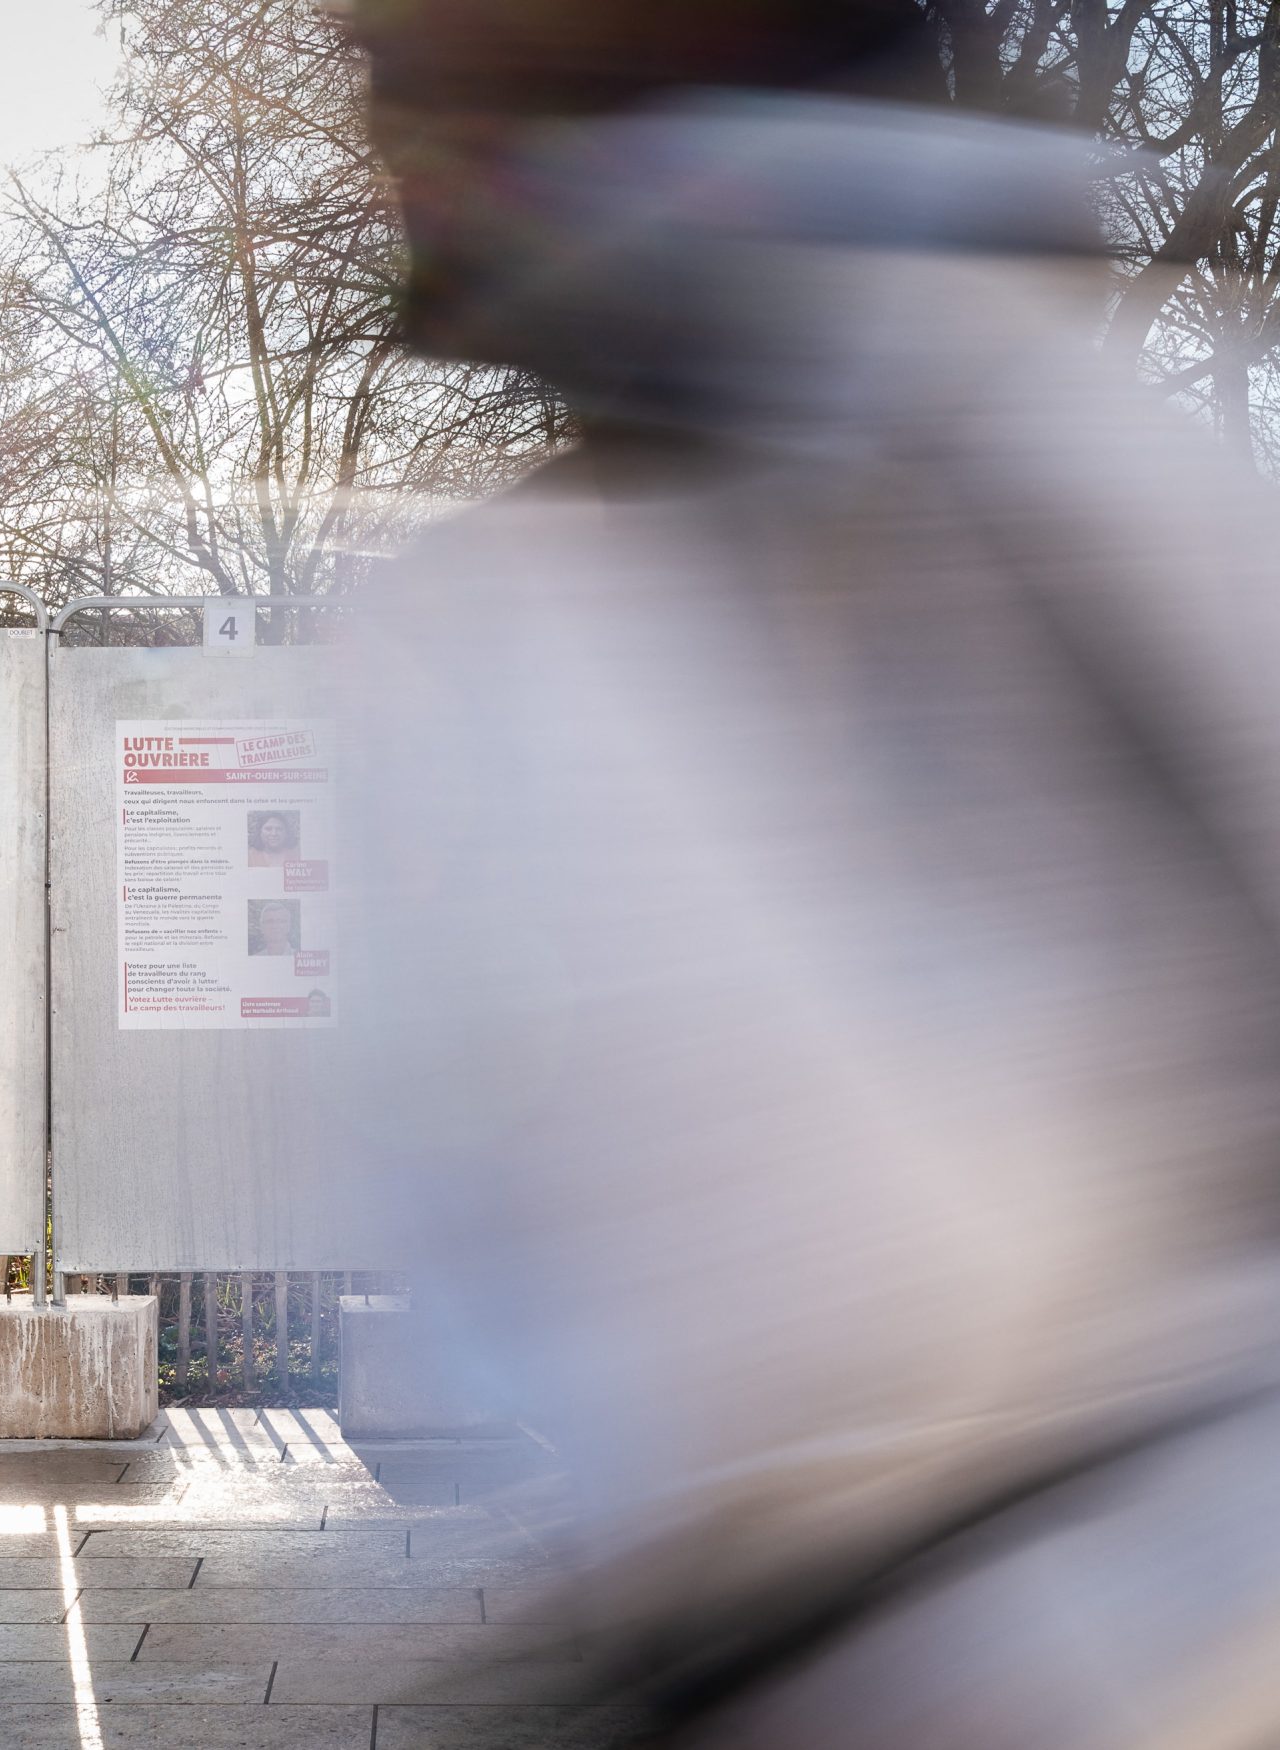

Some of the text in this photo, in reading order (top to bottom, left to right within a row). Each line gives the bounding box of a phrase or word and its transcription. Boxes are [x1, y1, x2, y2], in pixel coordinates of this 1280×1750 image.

[218, 616, 238, 640] 4
[124, 738, 173, 750] LUTTE
[242, 734, 306, 752] LE CAMP DES
[124, 750, 209, 767] OUVRIÈRE
[240, 745, 312, 765] TRAVAILLEURS
[226, 772, 328, 780] SAINT-OUEN-SUR-SEINE
[129, 1004, 226, 1012] Le camp des travailleurs!
